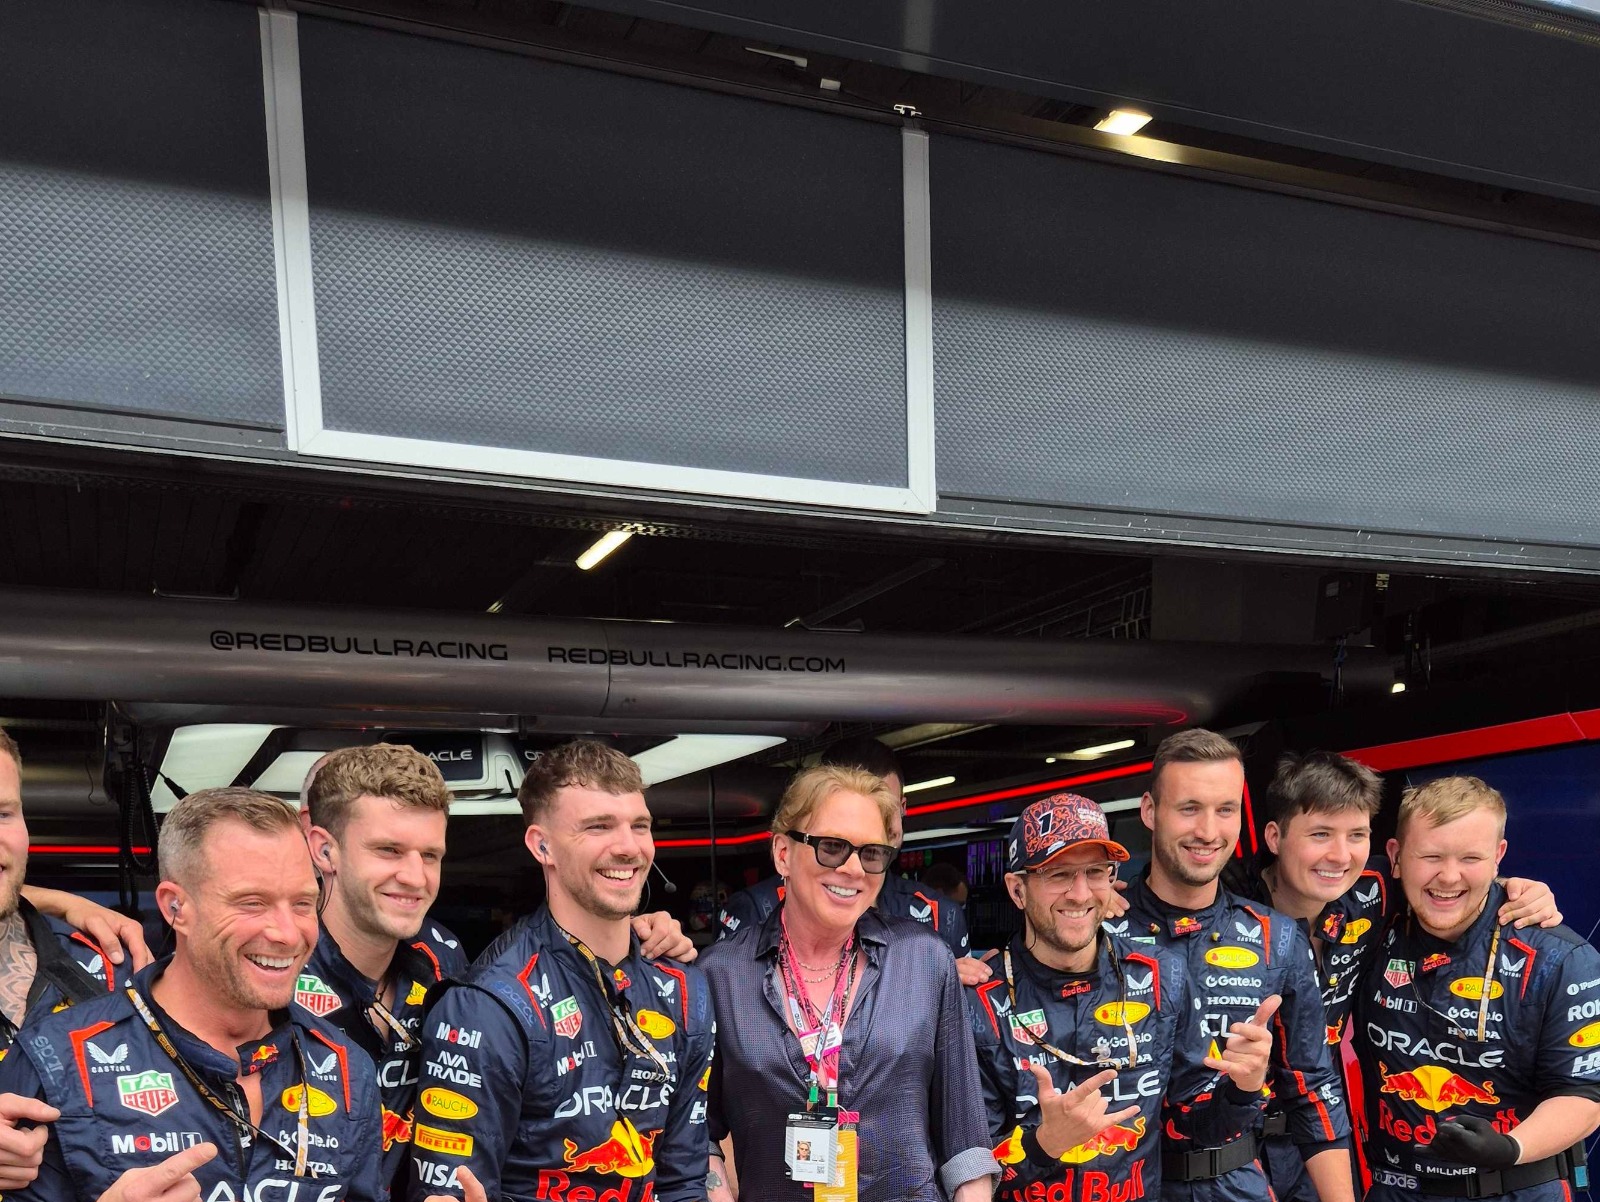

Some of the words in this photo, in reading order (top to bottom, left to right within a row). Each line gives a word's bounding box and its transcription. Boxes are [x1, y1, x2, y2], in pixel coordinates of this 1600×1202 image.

[210, 630, 508, 661] @REDBULLRACING
[547, 647, 846, 673] REDBULLRACING.COM
[421, 750, 473, 762] ACLE
[1218, 975, 1262, 988] Gate.io
[1464, 983, 1499, 993] RAUH
[298, 992, 340, 1013] HEUER
[1207, 995, 1260, 1007] HONDA
[1012, 1012, 1042, 1027] TAG
[1460, 1007, 1503, 1022] Gae.io
[436, 1022, 482, 1049] Mobil
[1110, 1032, 1152, 1048] Gae.io
[1367, 1022, 1505, 1068] ORACLE
[91, 1064, 132, 1074] CASTORE
[437, 1050, 469, 1070] AVA
[123, 1073, 170, 1092] TAG
[426, 1060, 482, 1088] TRADE
[124, 1090, 176, 1112] HEUER
[431, 1095, 469, 1114] RAUCH
[553, 1083, 675, 1119] ORACLE
[1379, 1098, 1437, 1145] Red
[111, 1131, 178, 1154] Mobil
[418, 1128, 467, 1152] PIRELLI
[413, 1157, 465, 1190] VISA
[1414, 1163, 1424, 1173] B.
[1426, 1165, 1477, 1176] MILLNER
